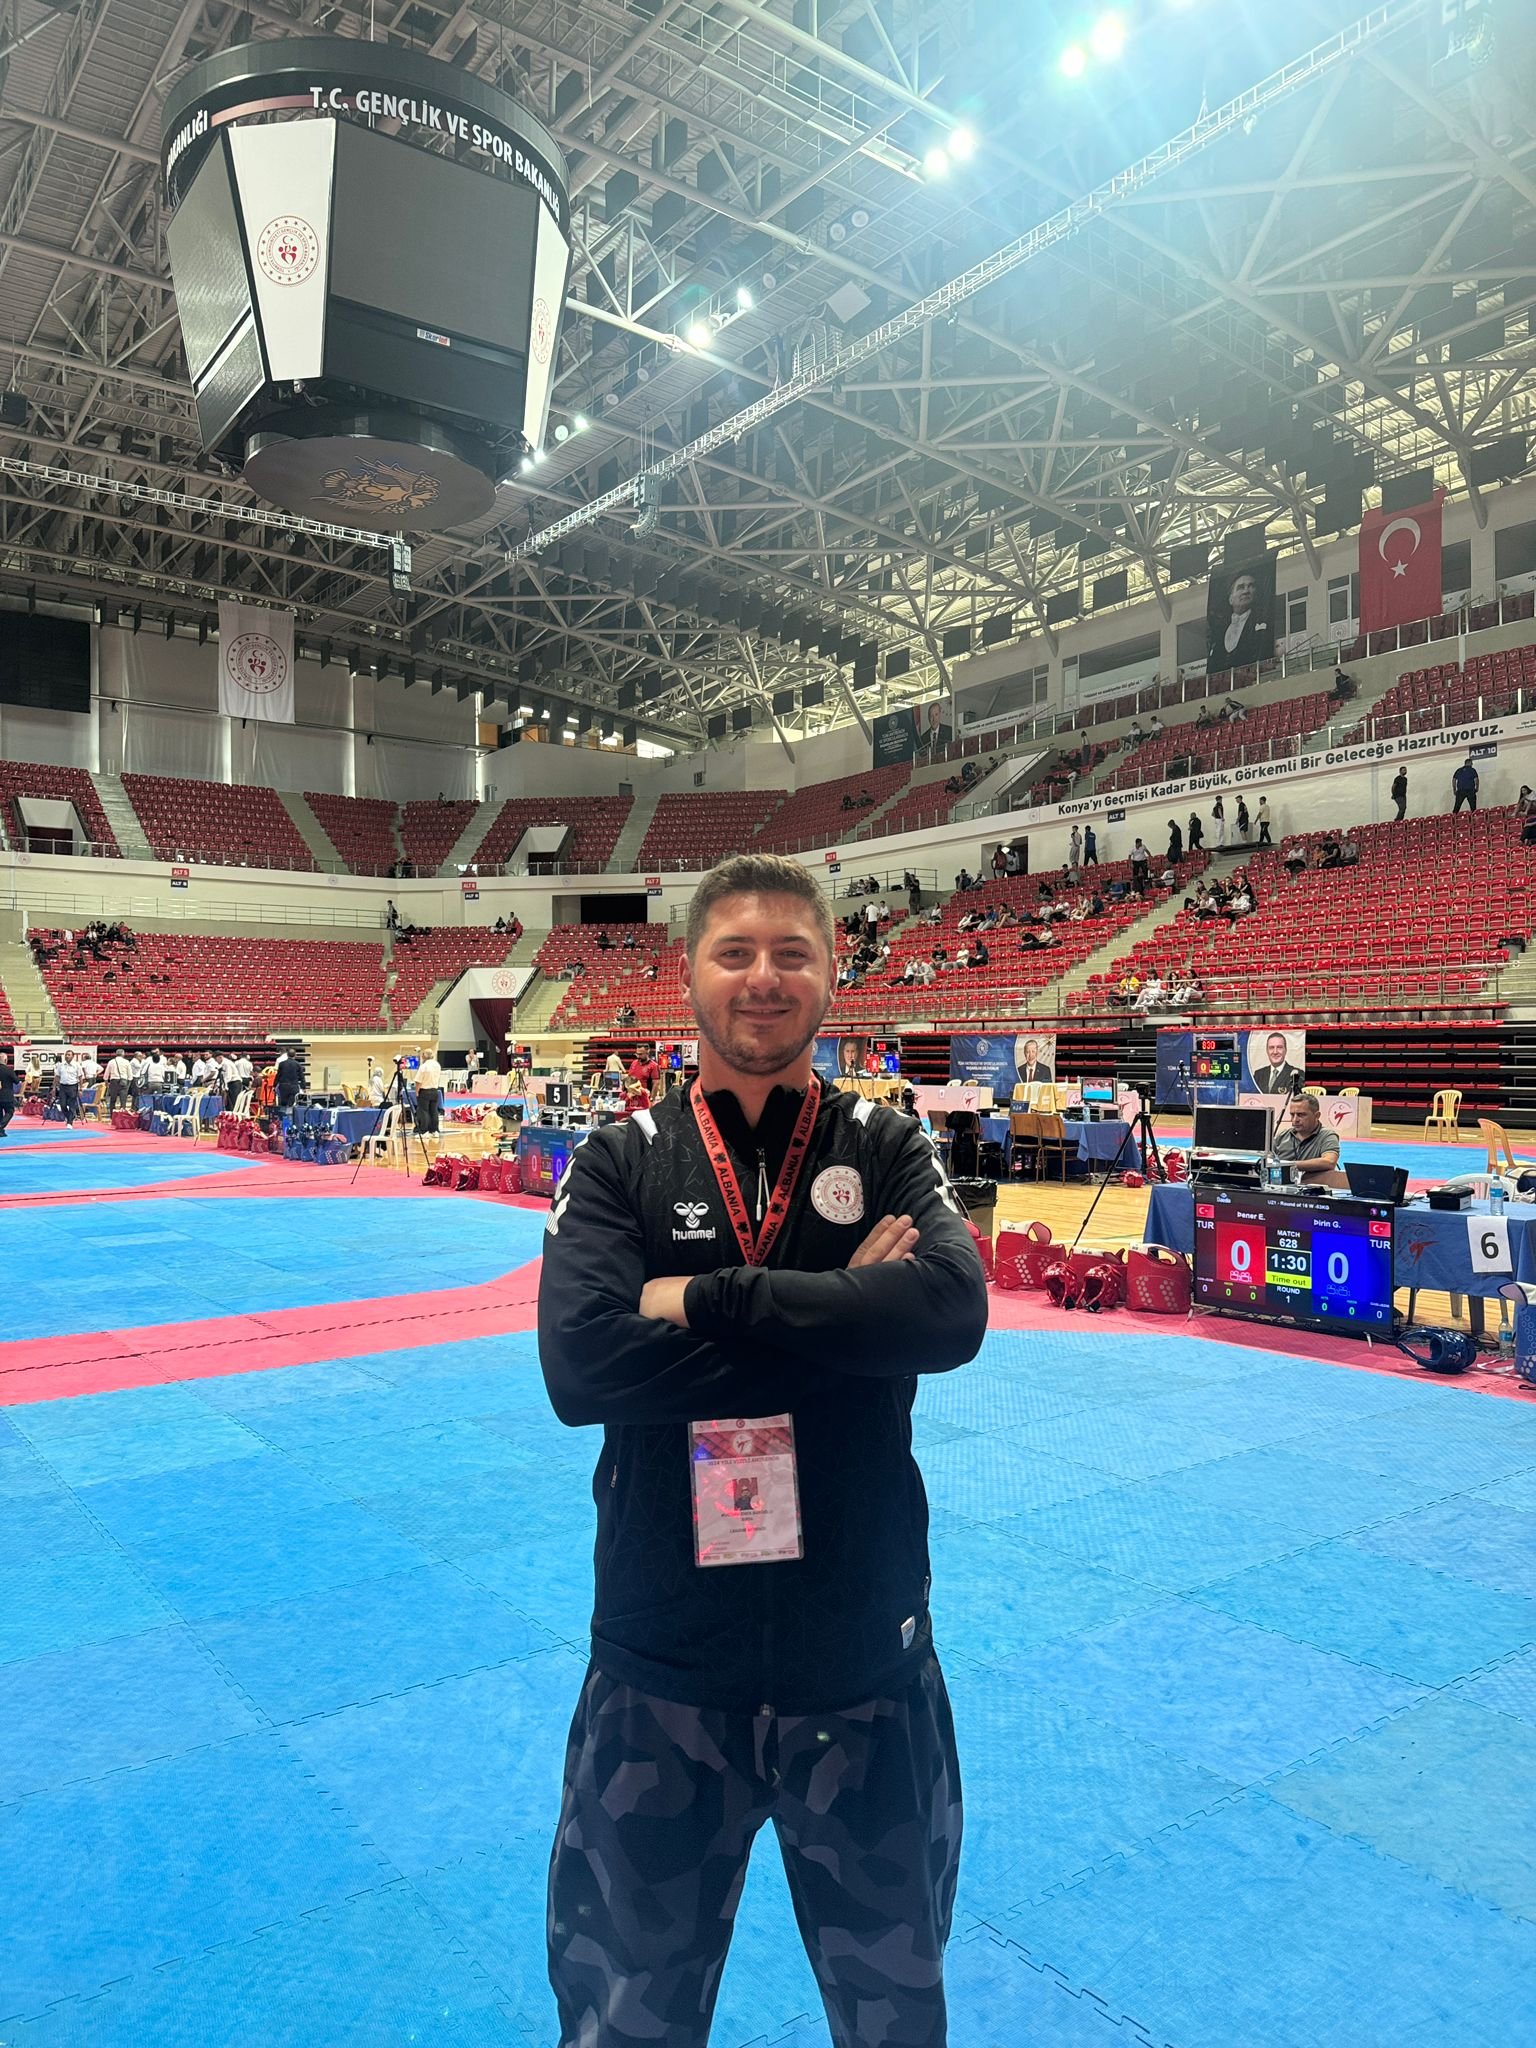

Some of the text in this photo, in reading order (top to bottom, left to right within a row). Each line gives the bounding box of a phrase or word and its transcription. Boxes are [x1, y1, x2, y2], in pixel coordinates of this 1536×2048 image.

[310, 86, 349, 111] T.C.
[356, 90, 441, 130] GENÇLİK
[446, 111, 469, 141] VE
[472, 124, 513, 167] SPOR
[1470, 746, 1497, 757] ALT 10
[1058, 797, 1101, 816] Konya'yı
[1104, 788, 1148, 807] Geçmişi
[1151, 782, 1186, 799] Kadar
[1189, 773, 1232, 793] Büyük,
[1235, 759, 1297, 783] Görkemli
[1301, 755, 1322, 770] Bir
[1325, 741, 1394, 765] Geleceğe
[1398, 723, 1504, 752] Hazırlıyoruz.
[1108, 813, 1119, 821] ALT
[1201, 1040, 1216, 1050] 830
[553, 1087, 561, 1104] 5
[799, 1095, 817, 1137] ALBANIA
[696, 1107, 719, 1150] ALBANIA
[531, 1155, 538, 1172] 0
[556, 1158, 563, 1176] 0
[778, 1153, 800, 1201] ALBANIA
[717, 1166, 741, 1218] ALBANIA
[1196, 1220, 1215, 1230] TUR
[1332, 1221, 1341, 1229] G.
[672, 1226, 716, 1241] hummel
[1276, 1230, 1301, 1238] MATCH
[1279, 1238, 1298, 1249] 628
[1369, 1239, 1391, 1250] TUR
[1480, 1231, 1500, 1260] 6
[1230, 1239, 1251, 1272] 0
[1271, 1253, 1307, 1272] 1:30
[1327, 1252, 1349, 1285] 0
[1271, 1275, 1306, 1287] Time out
[1202, 1284, 1208, 1292] 0
[1225, 1288, 1232, 1297] 0
[1276, 1286, 1301, 1295] ROUND
[1250, 1291, 1257, 1300] 0
[1285, 1295, 1291, 1304] 1
[1321, 1302, 1328, 1312] 0
[1348, 1306, 1355, 1316] 0
[1376, 1310, 1383, 1319] 0
